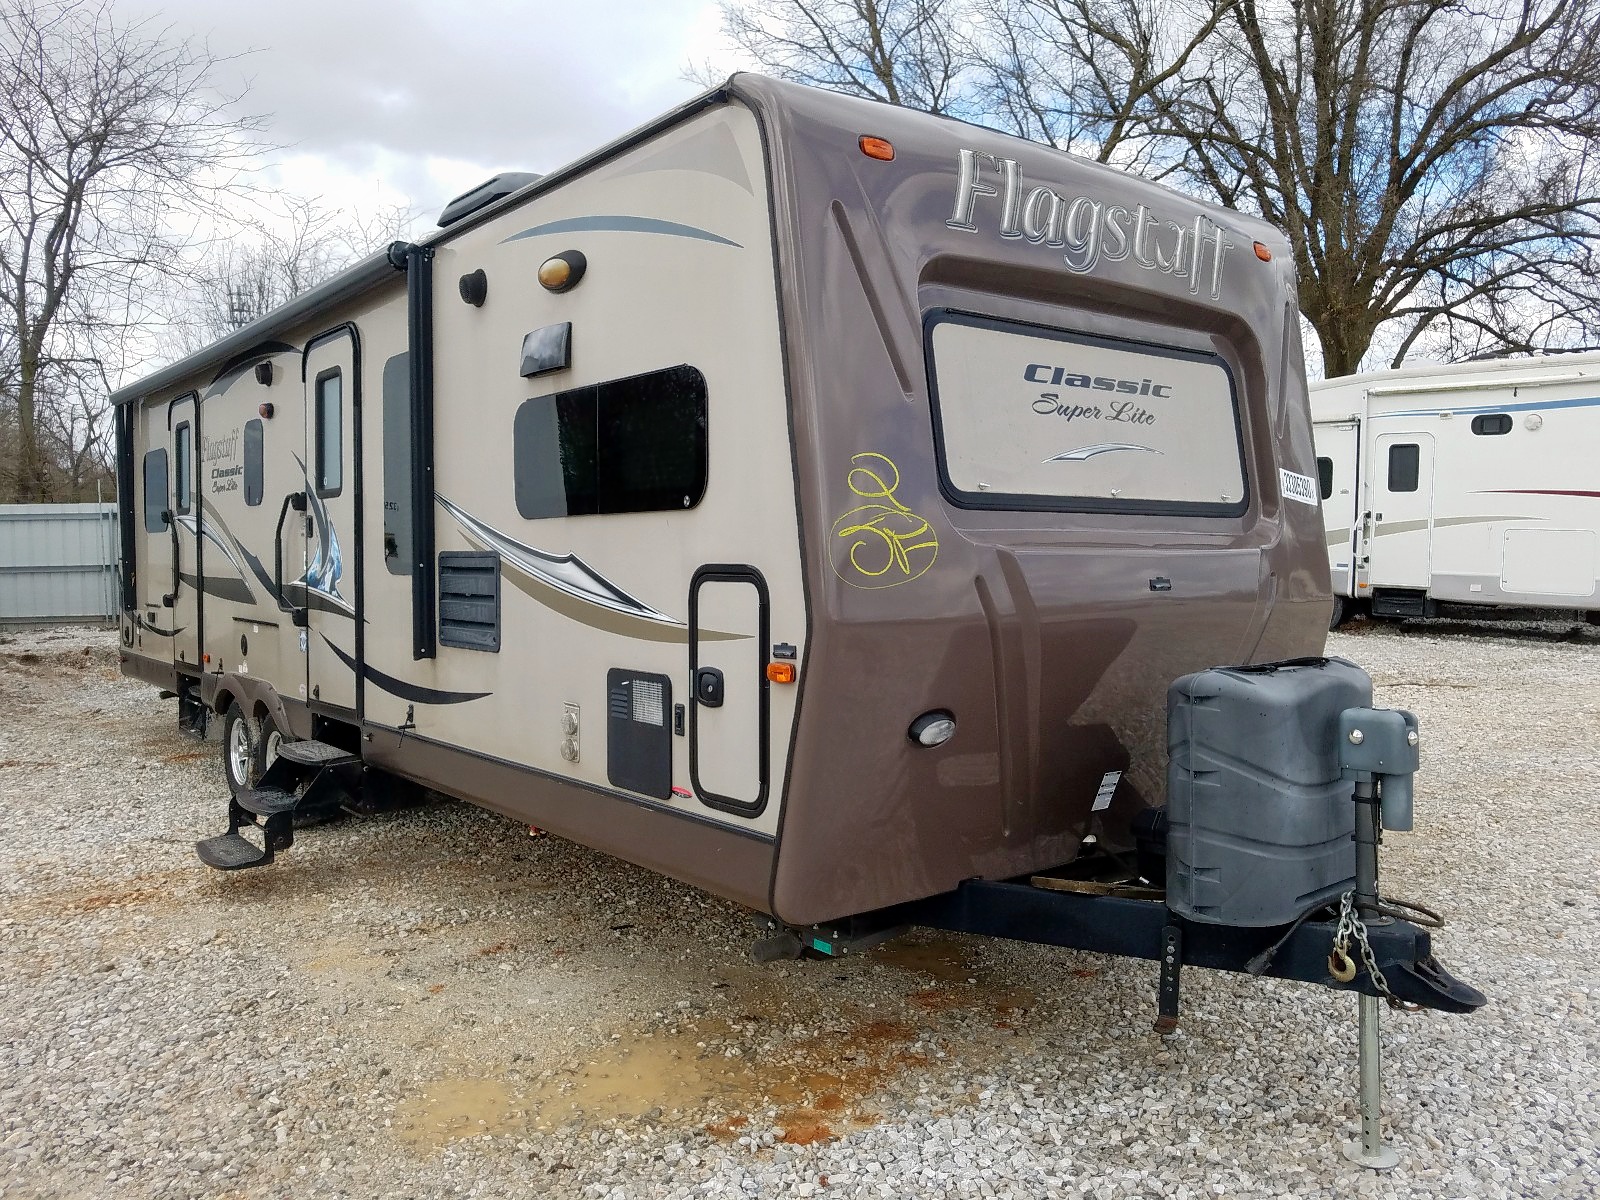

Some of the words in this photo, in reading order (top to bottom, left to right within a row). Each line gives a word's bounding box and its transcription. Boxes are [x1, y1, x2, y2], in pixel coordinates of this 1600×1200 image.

[945, 148, 1234, 299] Flagstaff
[1024, 363, 1173, 398] Classic
[1031, 392, 1102, 422] Super
[1104, 401, 1157, 426] Lite
[211, 464, 244, 480] Classic
